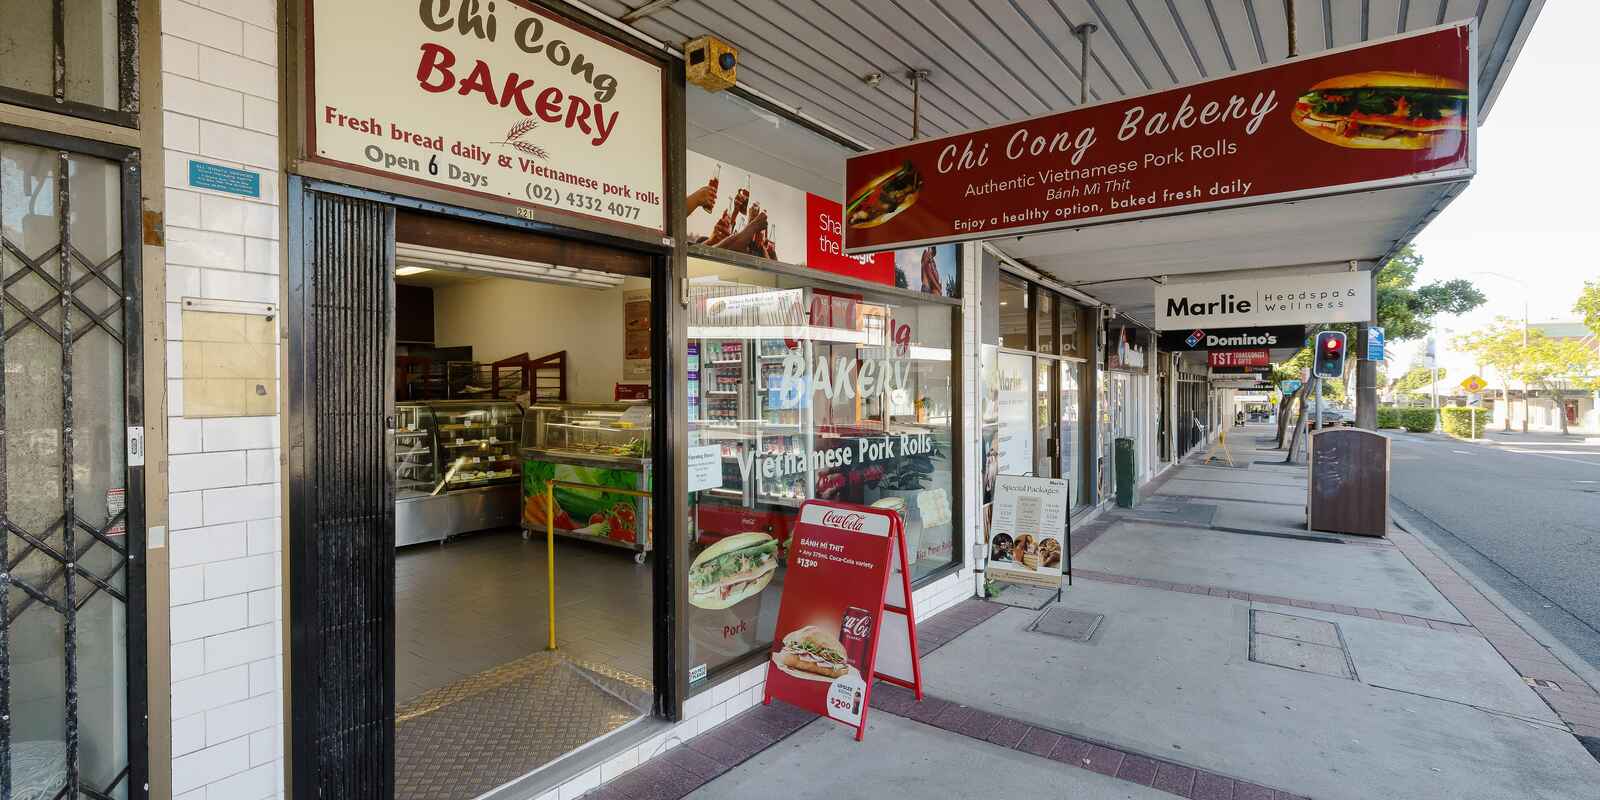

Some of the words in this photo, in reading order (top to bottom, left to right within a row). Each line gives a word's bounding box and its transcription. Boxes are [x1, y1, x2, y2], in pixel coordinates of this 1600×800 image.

[418, 0, 497, 42] Chi
[514, 17, 618, 103] Cong
[416, 42, 620, 147] BAKERY
[936, 139, 990, 174] Chi
[1006, 127, 1097, 166] Cong
[1117, 89, 1279, 142] Bakery
[324, 105, 383, 137] Fresh
[391, 123, 444, 152] bread
[451, 140, 491, 166] daily
[498, 154, 513, 170] &
[518, 156, 599, 191] Vietnamese
[602, 180, 631, 204] pork
[635, 186, 661, 206] rolls
[364, 144, 421, 176] Open
[428, 153, 439, 176] 6
[448, 163, 489, 188] Days
[964, 173, 1036, 198] Authentic
[1038, 158, 1139, 185] Vietnamese
[1144, 147, 1185, 169] Pork
[1191, 138, 1238, 161] Rolls
[525, 182, 561, 207] (02)
[565, 191, 603, 213] 4332
[607, 200, 641, 221] 4077
[954, 218, 985, 231] Enjoy
[990, 217, 998, 225] a
[1002, 207, 1049, 224] healthy
[1055, 202, 1104, 219] option,
[1110, 192, 1156, 209] baked
[1163, 184, 1201, 202] fresh
[1209, 178, 1252, 195] daily
[1046, 184, 1080, 201] Bánh
[819, 213, 842, 236] Sha
[819, 233, 839, 255] the
[1166, 294, 1251, 317] Marlie
[1264, 289, 1339, 302] Headspa
[1347, 288, 1356, 297] &
[1264, 300, 1344, 312] Wellness
[1206, 332, 1278, 347] Domino's
[1212, 352, 1232, 365] TST
[737, 444, 852, 482] Vietnamese
[858, 437, 896, 463] Pork
[900, 431, 932, 457] Rolls
[723, 620, 747, 639] Pork
